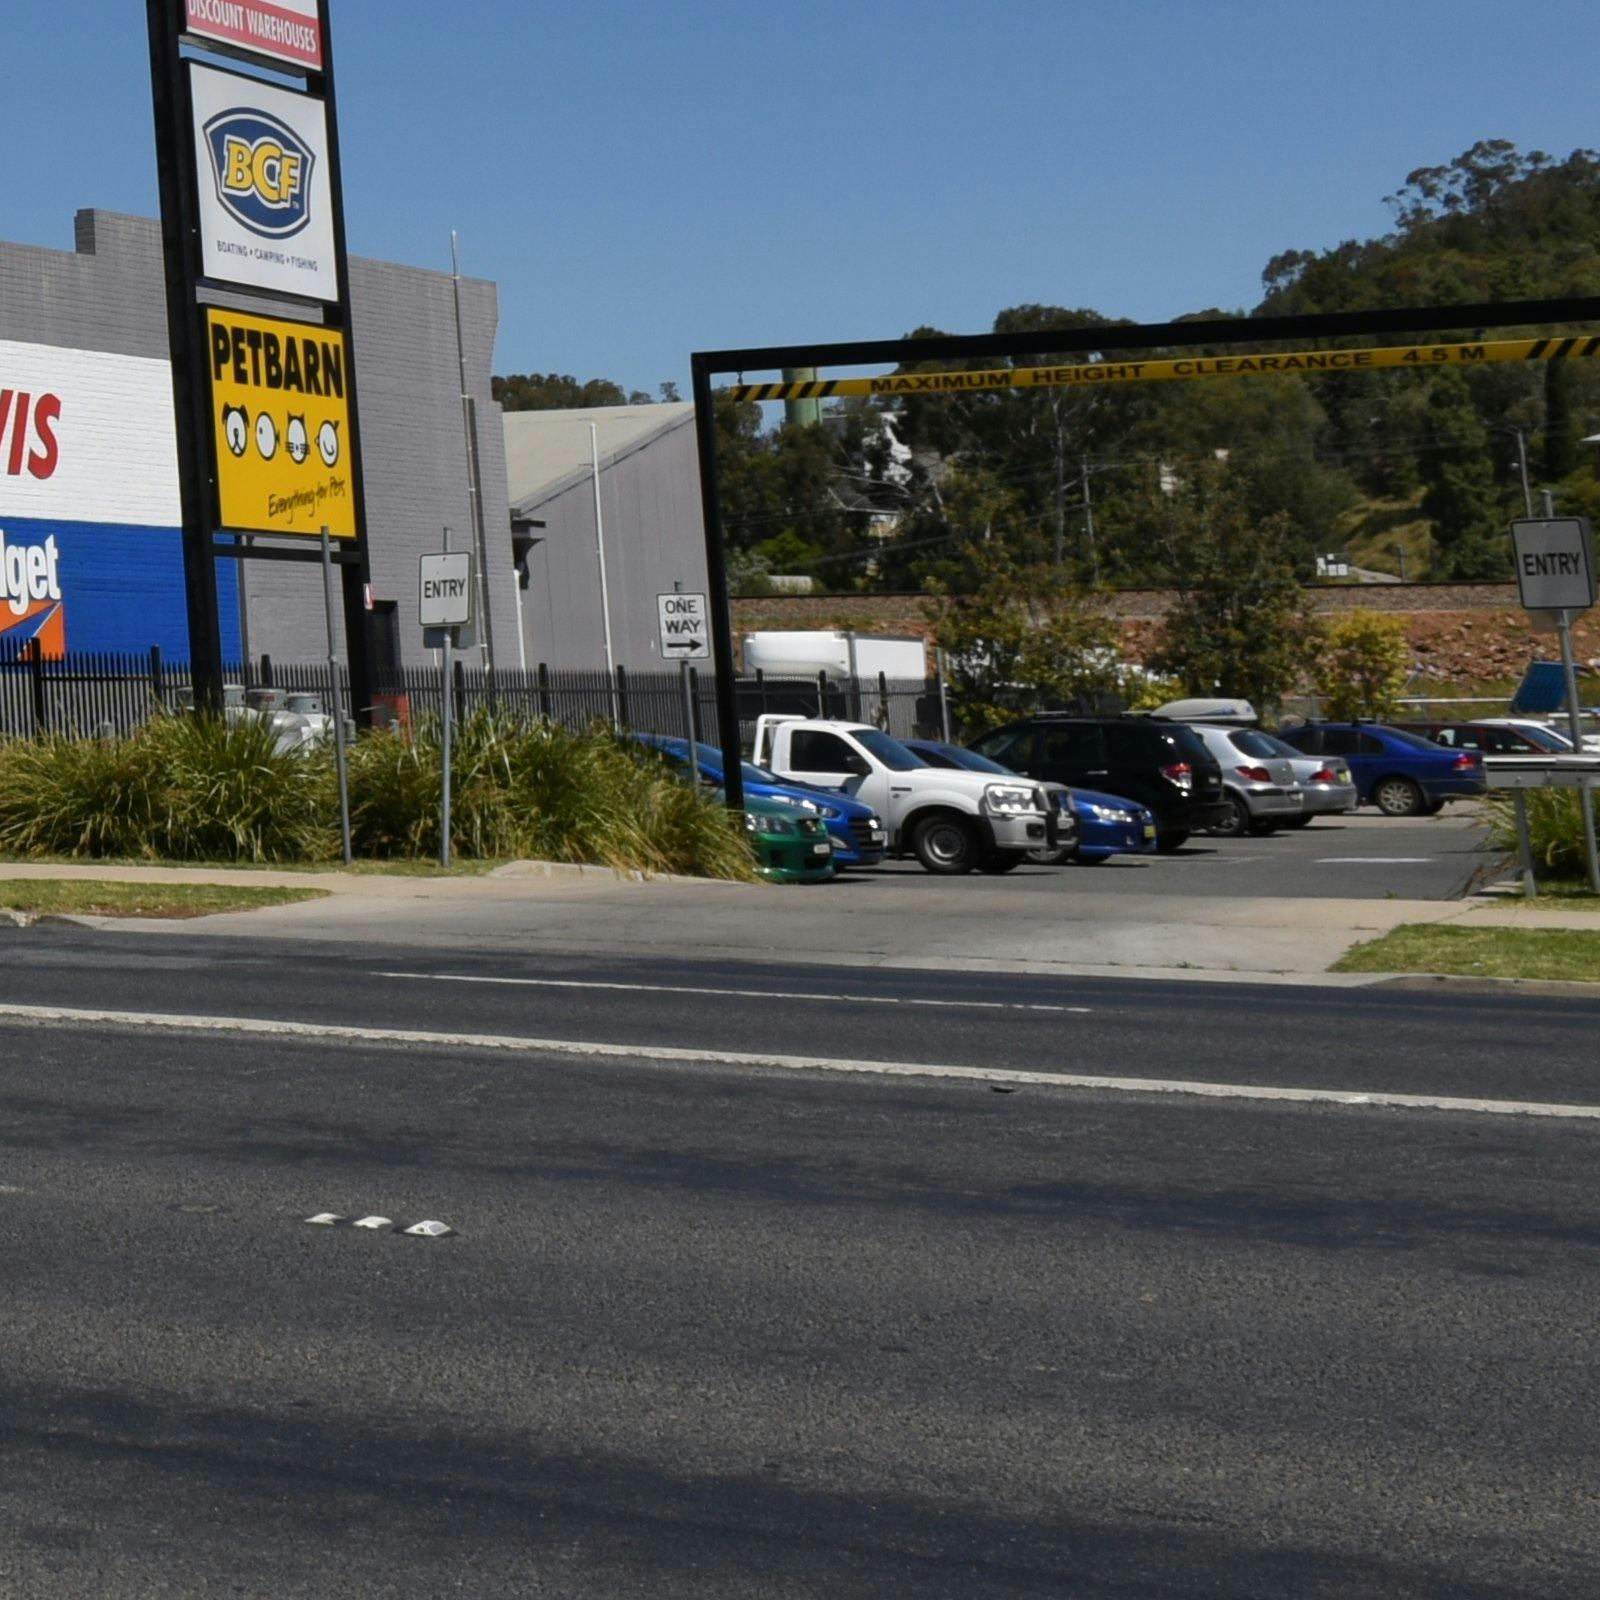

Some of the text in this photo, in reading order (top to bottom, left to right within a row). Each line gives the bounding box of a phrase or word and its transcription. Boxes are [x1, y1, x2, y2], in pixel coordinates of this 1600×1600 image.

[248, 10, 315, 53] WAREHOUSES
[224, 139, 300, 204] BCF
[216, 240, 318, 272] BOATING CAMPING FISHING
[211, 323, 344, 399] PETBARN
[870, 344, 1487, 394] MAXIMUM HEIGHT CLEARANCE 4.5 M
[1522, 552, 1580, 576] ENTRY
[424, 578, 466, 599] ENTRY
[665, 599, 698, 614] ONE
[665, 620, 701, 634] WAY
